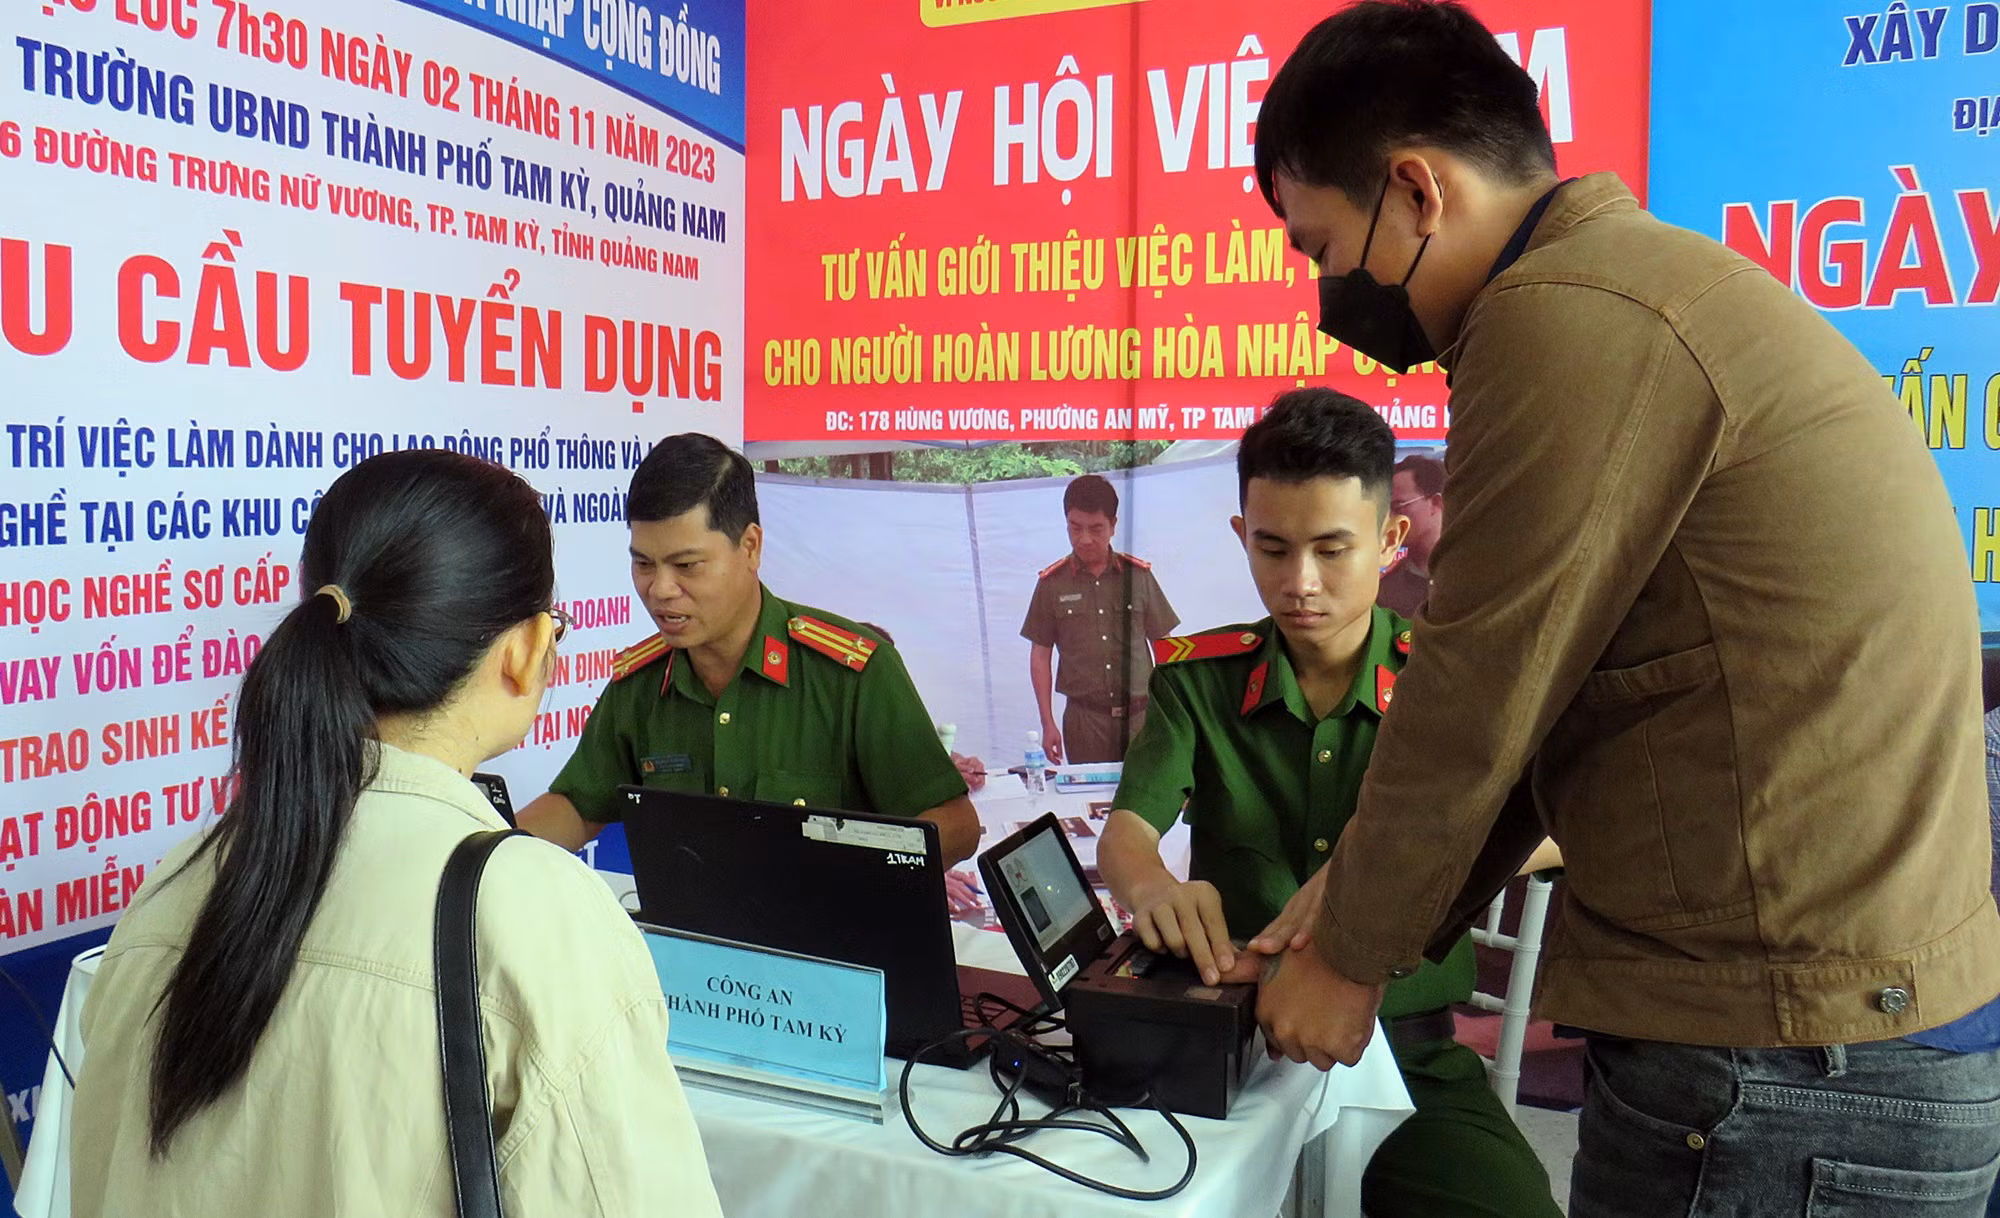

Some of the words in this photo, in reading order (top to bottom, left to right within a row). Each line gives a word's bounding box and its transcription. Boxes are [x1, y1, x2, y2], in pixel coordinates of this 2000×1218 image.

[583, 0, 652, 70] CỘNG
[659, 3, 721, 95] ĐỒNG
[1842, 4, 1949, 66] XÂY
[212, 0, 308, 70] 7h30
[321, 28, 413, 98] NGÀY
[422, 60, 460, 112] 02
[469, 73, 560, 141] THÁNG
[569, 105, 595, 150] 11
[606, 113, 659, 169] NĂM
[665, 134, 716, 184] 2023
[781, 73, 962, 203] NGÀY
[993, 55, 1114, 207] HỘI
[16, 36, 195, 126] TRƯỜNG
[208, 83, 310, 150] UBND
[321, 110, 426, 176] THÀNH
[436, 137, 493, 190] PHỐ
[501, 156, 552, 204] TAM
[560, 166, 597, 218] KỲ,
[604, 178, 676, 233] QUẢNG
[682, 199, 727, 244] NAM
[33, 127, 158, 183] ĐƯỜNG
[168, 152, 270, 202] TRƯNG
[280, 172, 323, 209] NỮ
[328, 185, 420, 233] VƯƠNG,
[427, 202, 459, 236] TP.
[465, 210, 508, 245] TAM
[514, 212, 546, 255] KỲ,
[552, 222, 594, 264] TỈNH
[600, 237, 658, 272] QUẢNG
[662, 248, 700, 281] NAM
[821, 247, 862, 302] TƯ
[866, 231, 926, 299] VẤN
[936, 233, 1001, 297] GIỚI
[1010, 228, 1106, 304] THIỆU
[1116, 224, 1193, 299] VIỆC
[1205, 219, 1295, 288] LÀM,
[1, 238, 73, 357] U
[117, 229, 310, 373] CẦU
[340, 268, 563, 390] TUYỂN
[585, 316, 723, 413] DỤNG
[764, 338, 821, 387] CHO
[830, 325, 926, 384] NGƯỜI
[932, 321, 1017, 383] HOÀN
[1029, 327, 1141, 381] LƯƠNG
[1152, 312, 1224, 379] HÒA
[1237, 311, 1340, 387] NHẬP
[6, 416, 66, 468] TRÍ
[78, 418, 155, 477] VIỆC
[168, 420, 234, 468] LÀM
[246, 422, 323, 468] DÀNH
[510, 426, 551, 469] PHỔ
[557, 433, 616, 470] THÔNG
[621, 437, 643, 470] VÀ
[825, 408, 855, 432] ĐC:
[858, 408, 891, 432] 178
[894, 402, 947, 431] HÙNG
[950, 404, 1015, 434] VƯƠNG,
[1020, 402, 1098, 431] PHƯỜNG
[1104, 408, 1134, 430] AN
[1138, 403, 1174, 432] MỸ,
[1181, 408, 1205, 429] TP
[1212, 407, 1254, 429] TAM
[80, 501, 134, 552] TẠI
[147, 491, 211, 540] CÁC
[223, 498, 281, 537] KHU
[0, 578, 70, 633] HỌC
[84, 558, 172, 619] NGHỀ
[183, 565, 224, 609] SƠ
[233, 552, 290, 606] CẤP
[573, 595, 630, 630] DOANH
[0, 656, 61, 704] VAY
[73, 634, 142, 695] VỐN
[152, 625, 194, 685] ĐỂ
[202, 628, 262, 678] ĐÀO
[0, 728, 90, 783] TRAO
[101, 714, 180, 766] SINH
[191, 693, 230, 750] KẾ
[534, 711, 560, 750] TẠI
[55, 791, 152, 852] ĐỘNG
[162, 776, 204, 826] TƯ
[56, 855, 145, 926] MIỄN
[707, 974, 761, 1001] CÔNG
[767, 988, 793, 1006] AN
[770, 1014, 812, 1037] TAM
